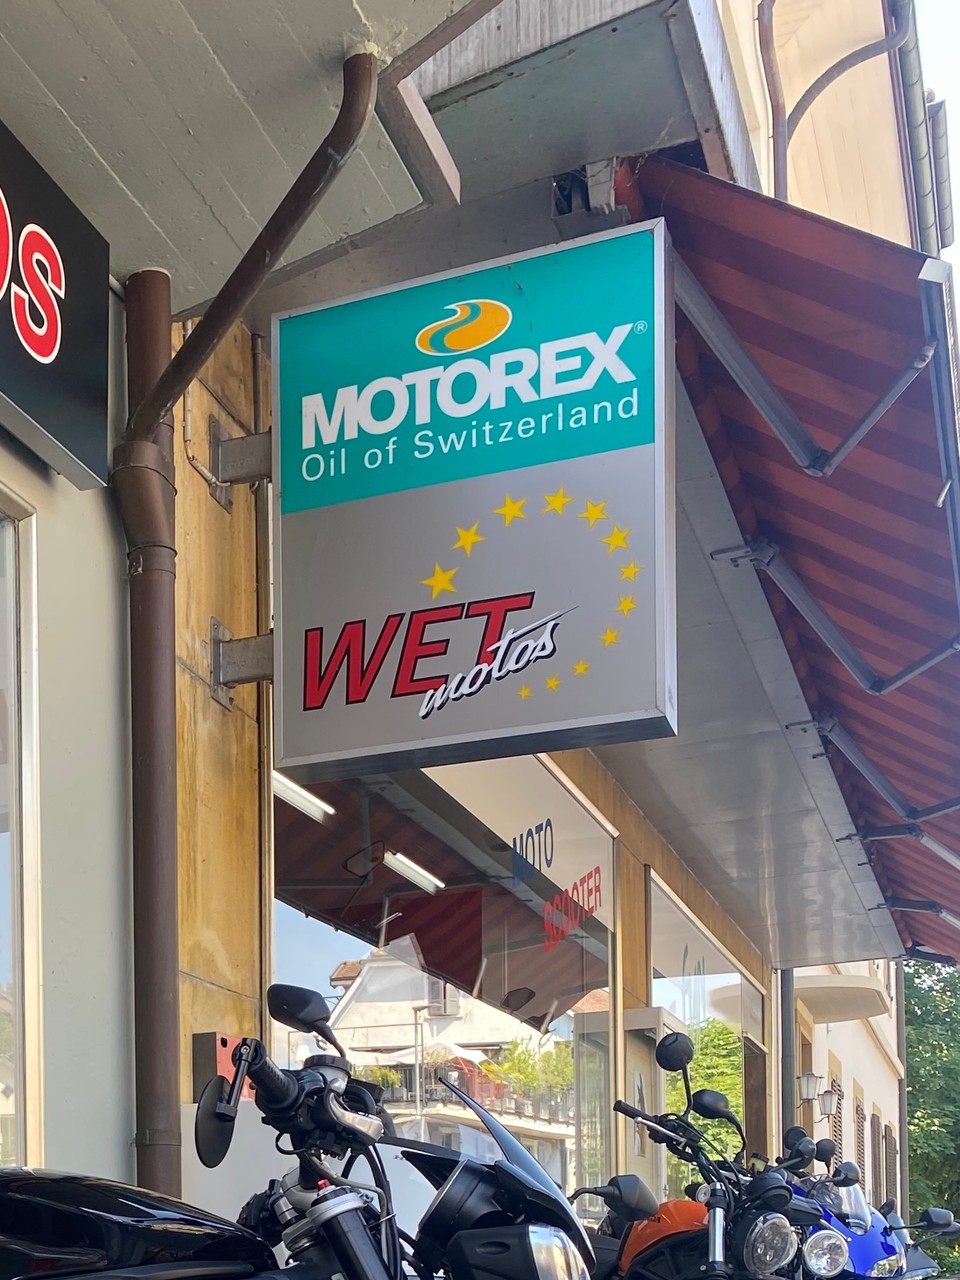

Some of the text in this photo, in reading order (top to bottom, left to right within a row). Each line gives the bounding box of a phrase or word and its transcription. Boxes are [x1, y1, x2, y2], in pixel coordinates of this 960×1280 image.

[301, 322, 636, 450] MOTOREX
[301, 389, 640, 481] Oil of Switzerland
[302, 591, 535, 711] WET
[419, 604, 579, 720] motos
[512, 818, 554, 888] MOTO
[543, 865, 602, 953] SCOOTER
